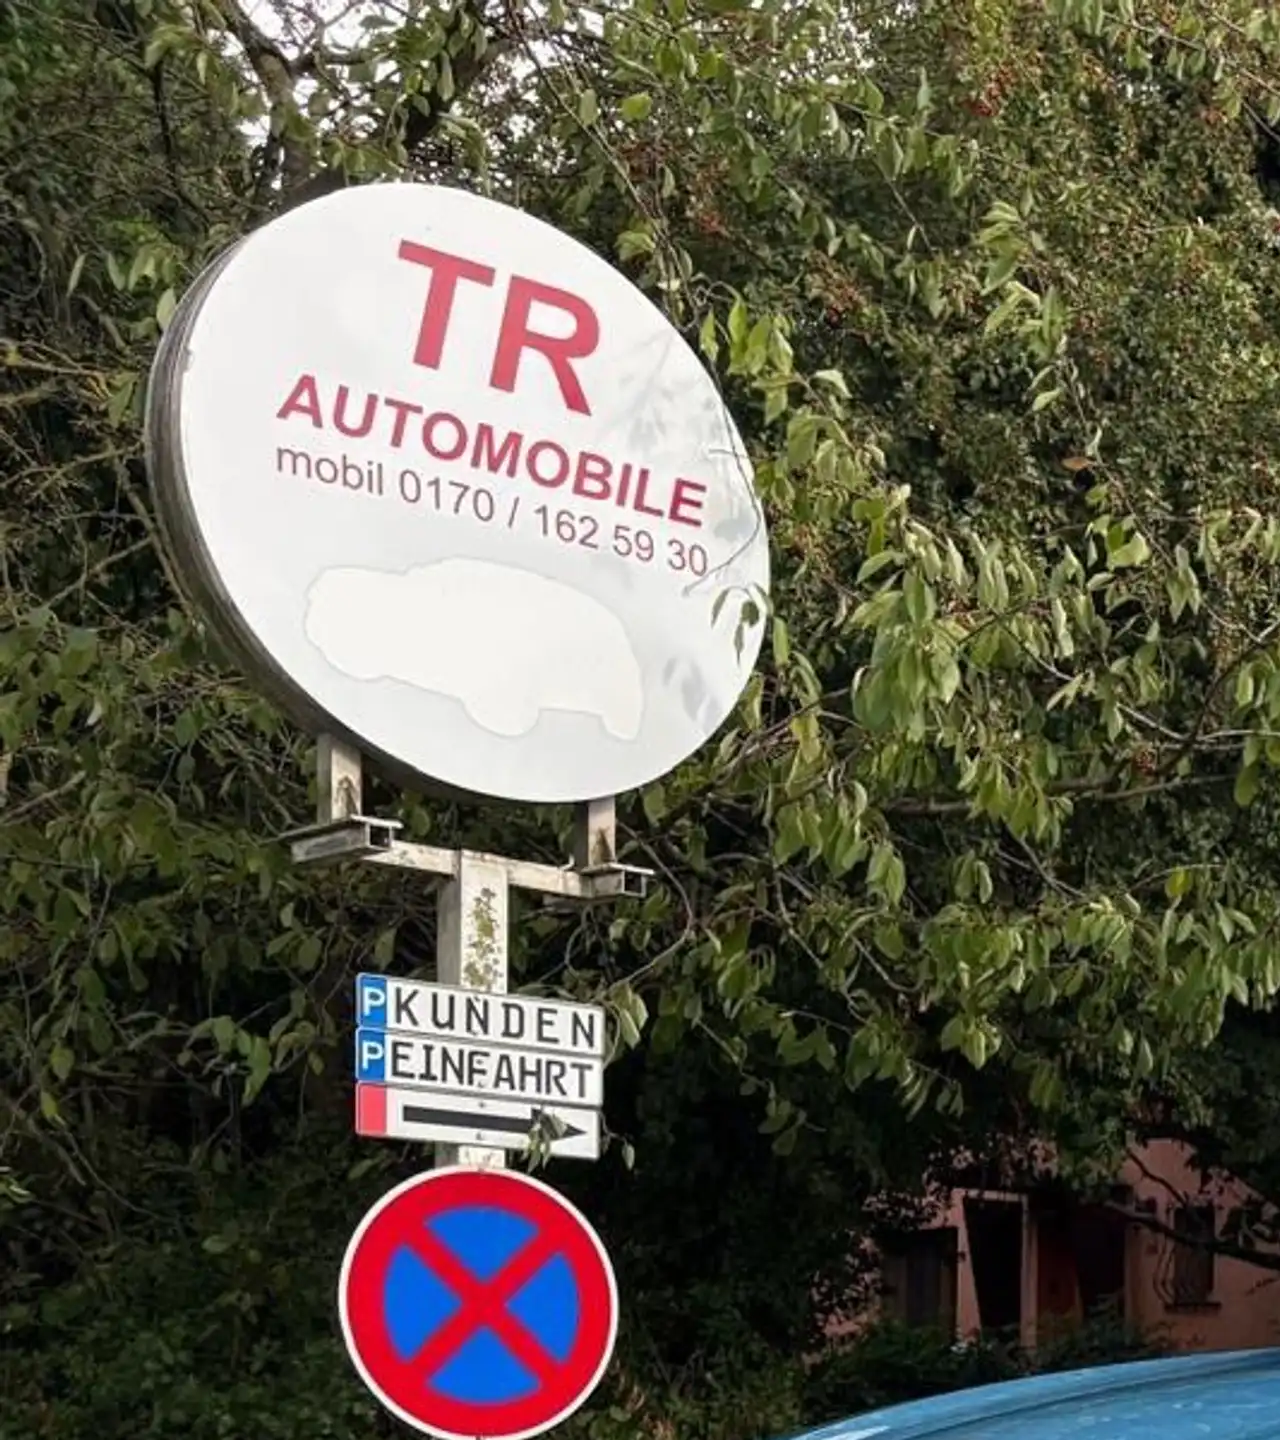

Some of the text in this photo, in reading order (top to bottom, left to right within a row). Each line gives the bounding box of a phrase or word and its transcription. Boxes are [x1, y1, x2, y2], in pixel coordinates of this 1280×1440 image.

[398, 239, 600, 417] TR
[276, 374, 707, 527] AUTOMOBILE
[277, 446, 708, 576] mobil 0170 / 162 59 30
[391, 1040, 593, 1098] EINFAHRT
[395, 986, 595, 1049] KUNDEN
